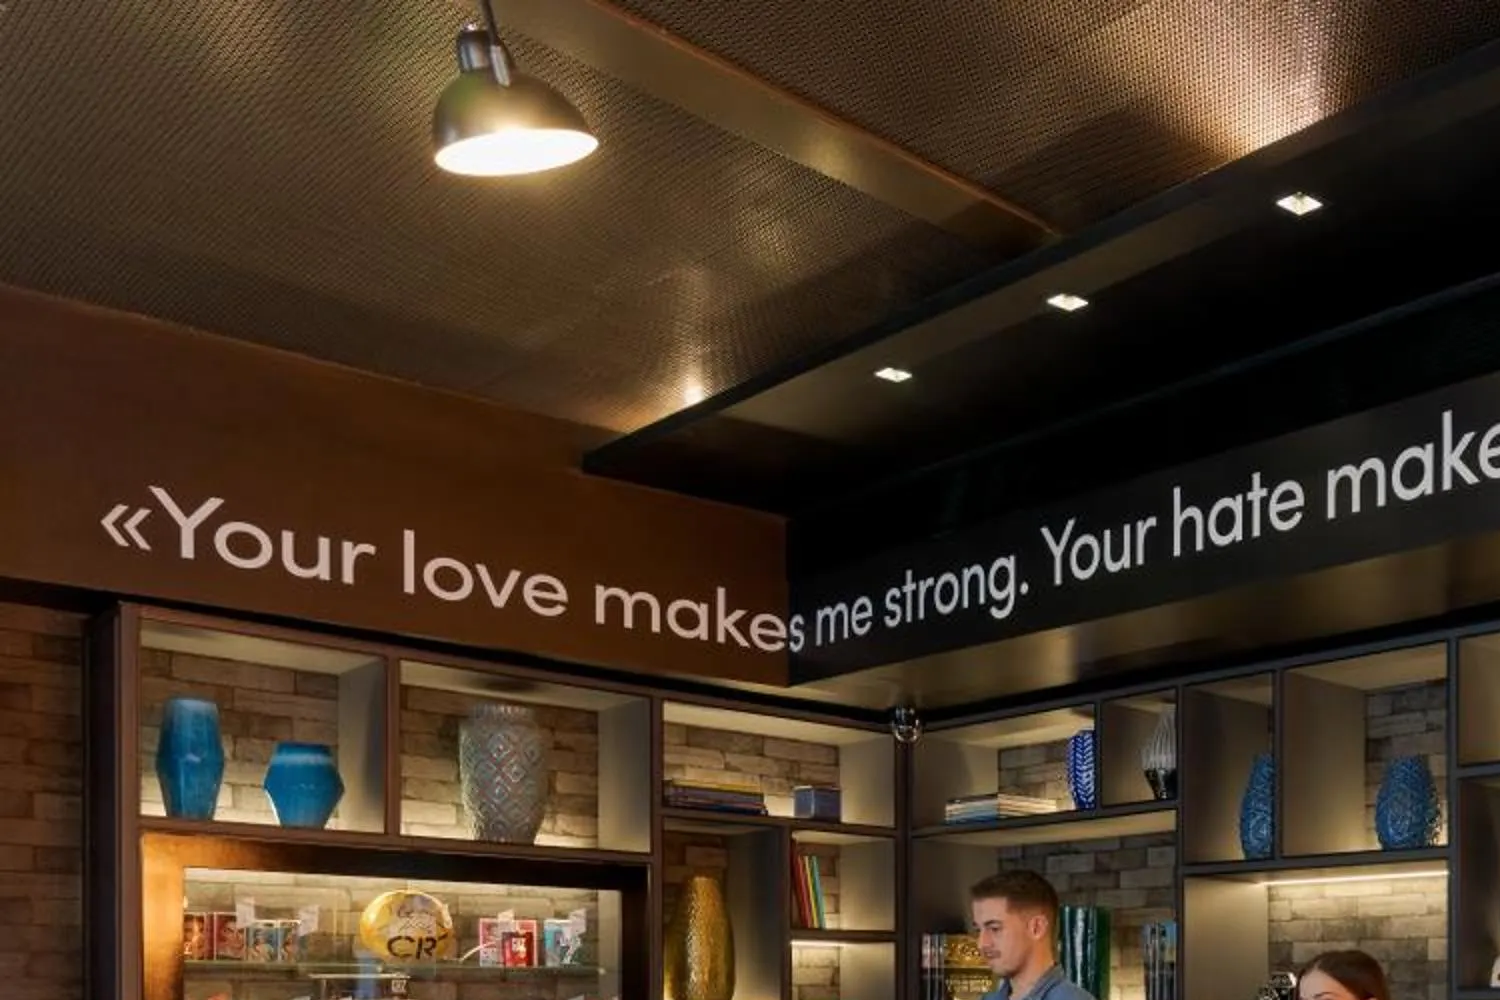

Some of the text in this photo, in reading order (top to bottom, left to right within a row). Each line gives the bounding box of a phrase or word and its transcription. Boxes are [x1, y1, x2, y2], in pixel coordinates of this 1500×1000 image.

[100, 484, 377, 586] «Your
[403, 529, 568, 617] love
[595, 584, 805, 653] makes
[816, 595, 873, 646] me
[884, 554, 1030, 619] strong.
[1040, 517, 1157, 586] Your
[1172, 472, 1305, 558] hate
